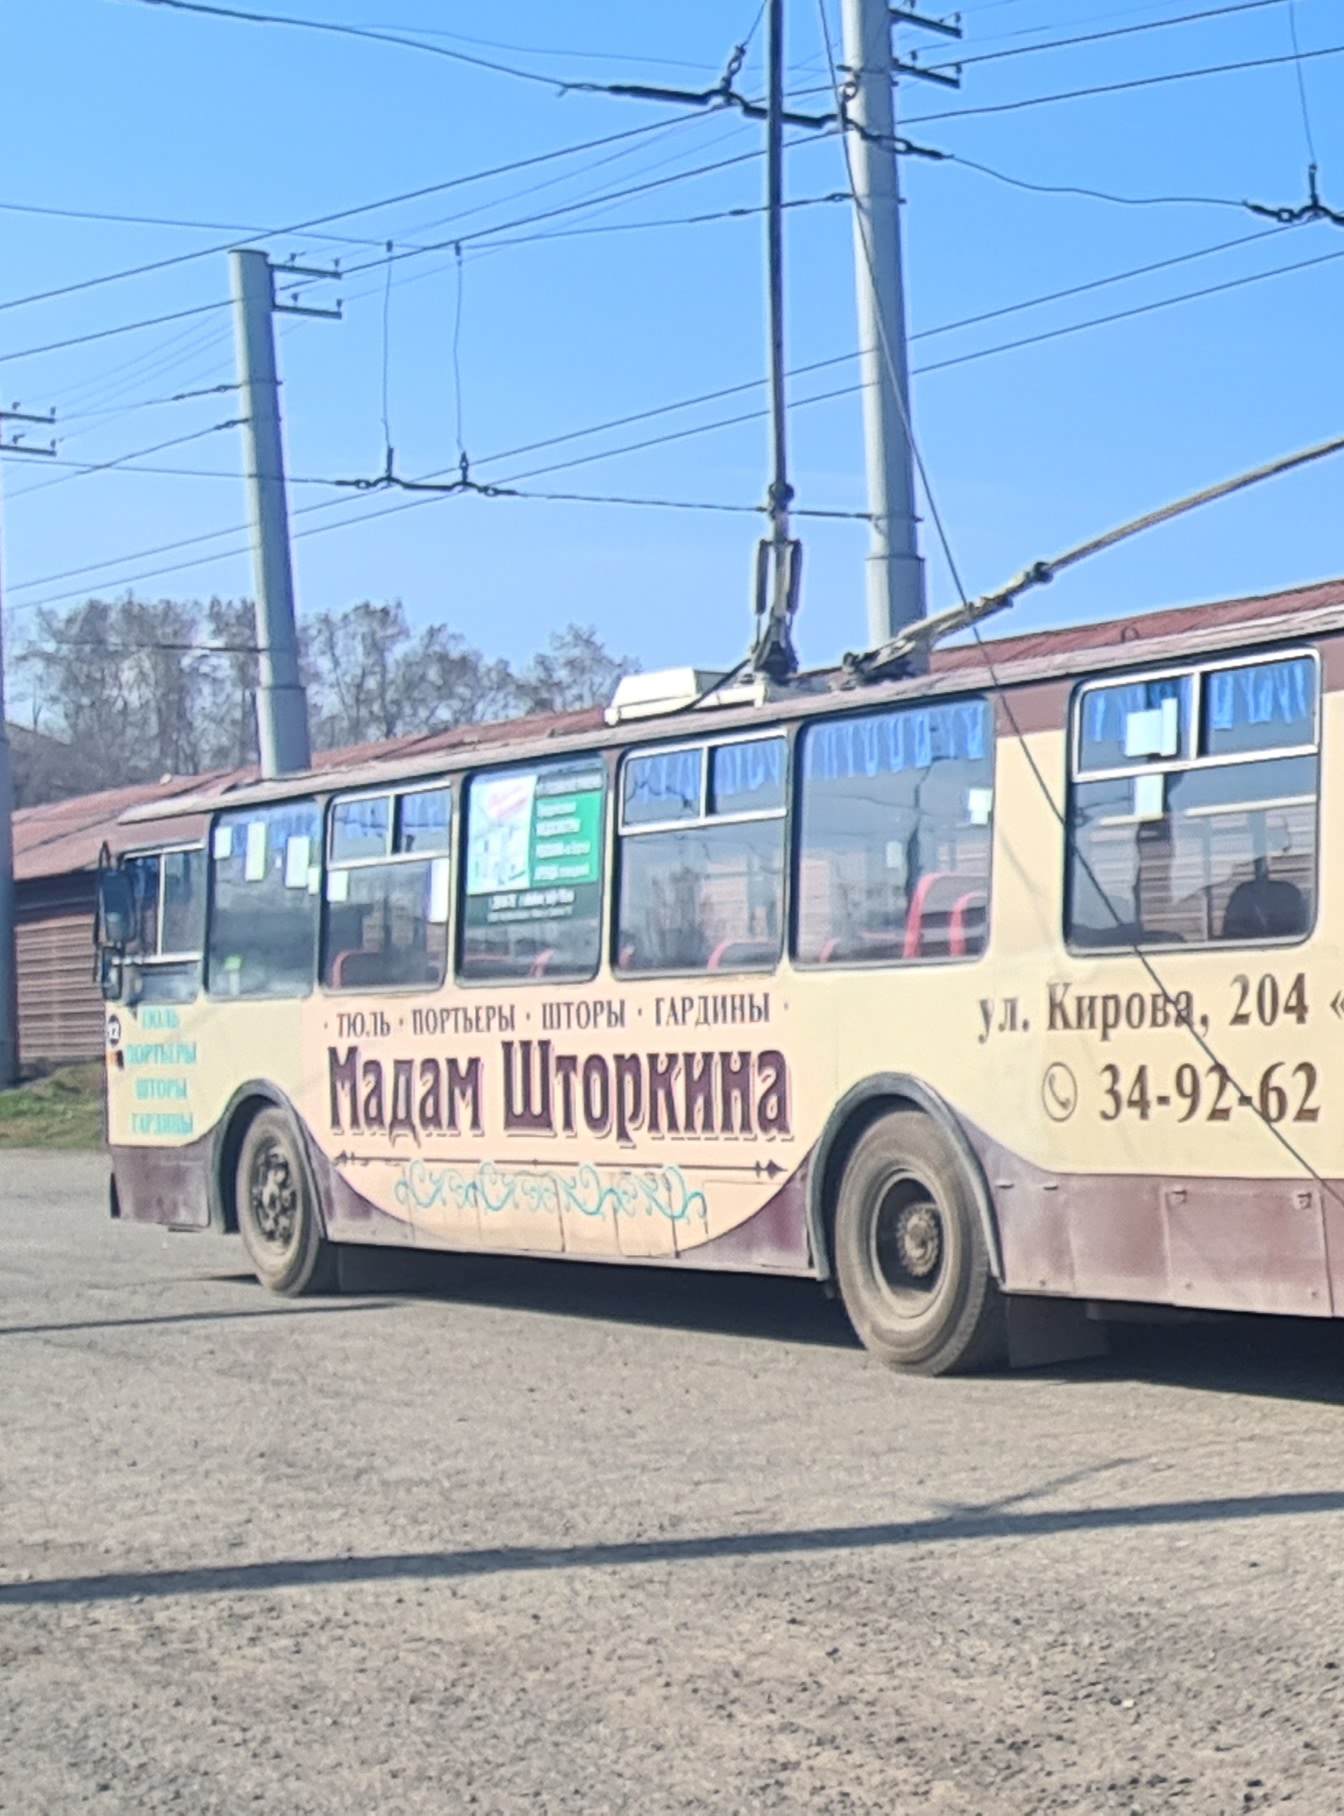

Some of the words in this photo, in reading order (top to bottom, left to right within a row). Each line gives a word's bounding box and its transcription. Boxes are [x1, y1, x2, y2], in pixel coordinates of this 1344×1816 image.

[336, 1011, 391, 1039] ТЮЛЬ
[411, 1004, 516, 1035] ПОРТЬЕРЫ
[541, 1000, 626, 1030] ШТОРЫ
[653, 993, 771, 1029] ГАРДИНЫ
[978, 996, 1030, 1044] ул.
[1045, 981, 1209, 1041] Кирова,
[1229, 972, 1310, 1027] 204
[327, 1044, 484, 1148] Мадам
[500, 1038, 794, 1150] Шторкина
[1099, 1061, 1321, 1124] 34-92-62
